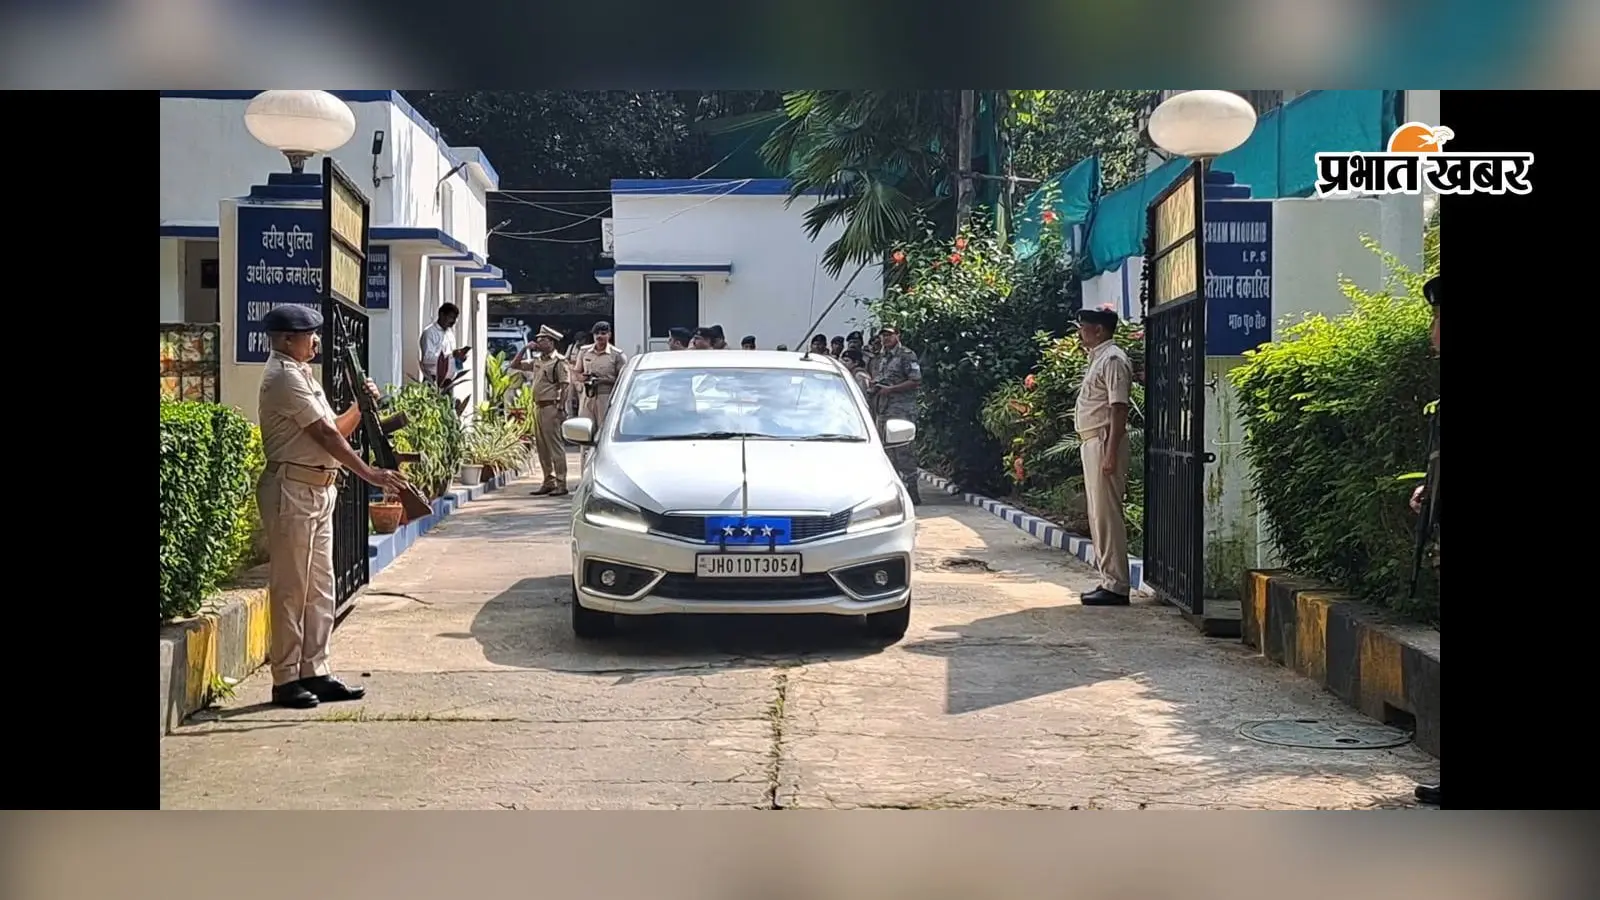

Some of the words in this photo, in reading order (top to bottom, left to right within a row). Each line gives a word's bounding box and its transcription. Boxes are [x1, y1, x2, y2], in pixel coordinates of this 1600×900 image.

[262, 224, 285, 250] वरीय
[287, 224, 313, 257] पुलिस
[1204, 221, 1228, 243] ESHAM
[246, 258, 284, 285] अधीक्षक
[286, 259, 323, 293] जमशेदपु
[248, 331, 257, 353] OF
[258, 331, 272, 353] POL
[707, 557, 798, 574] JH01DT3054
